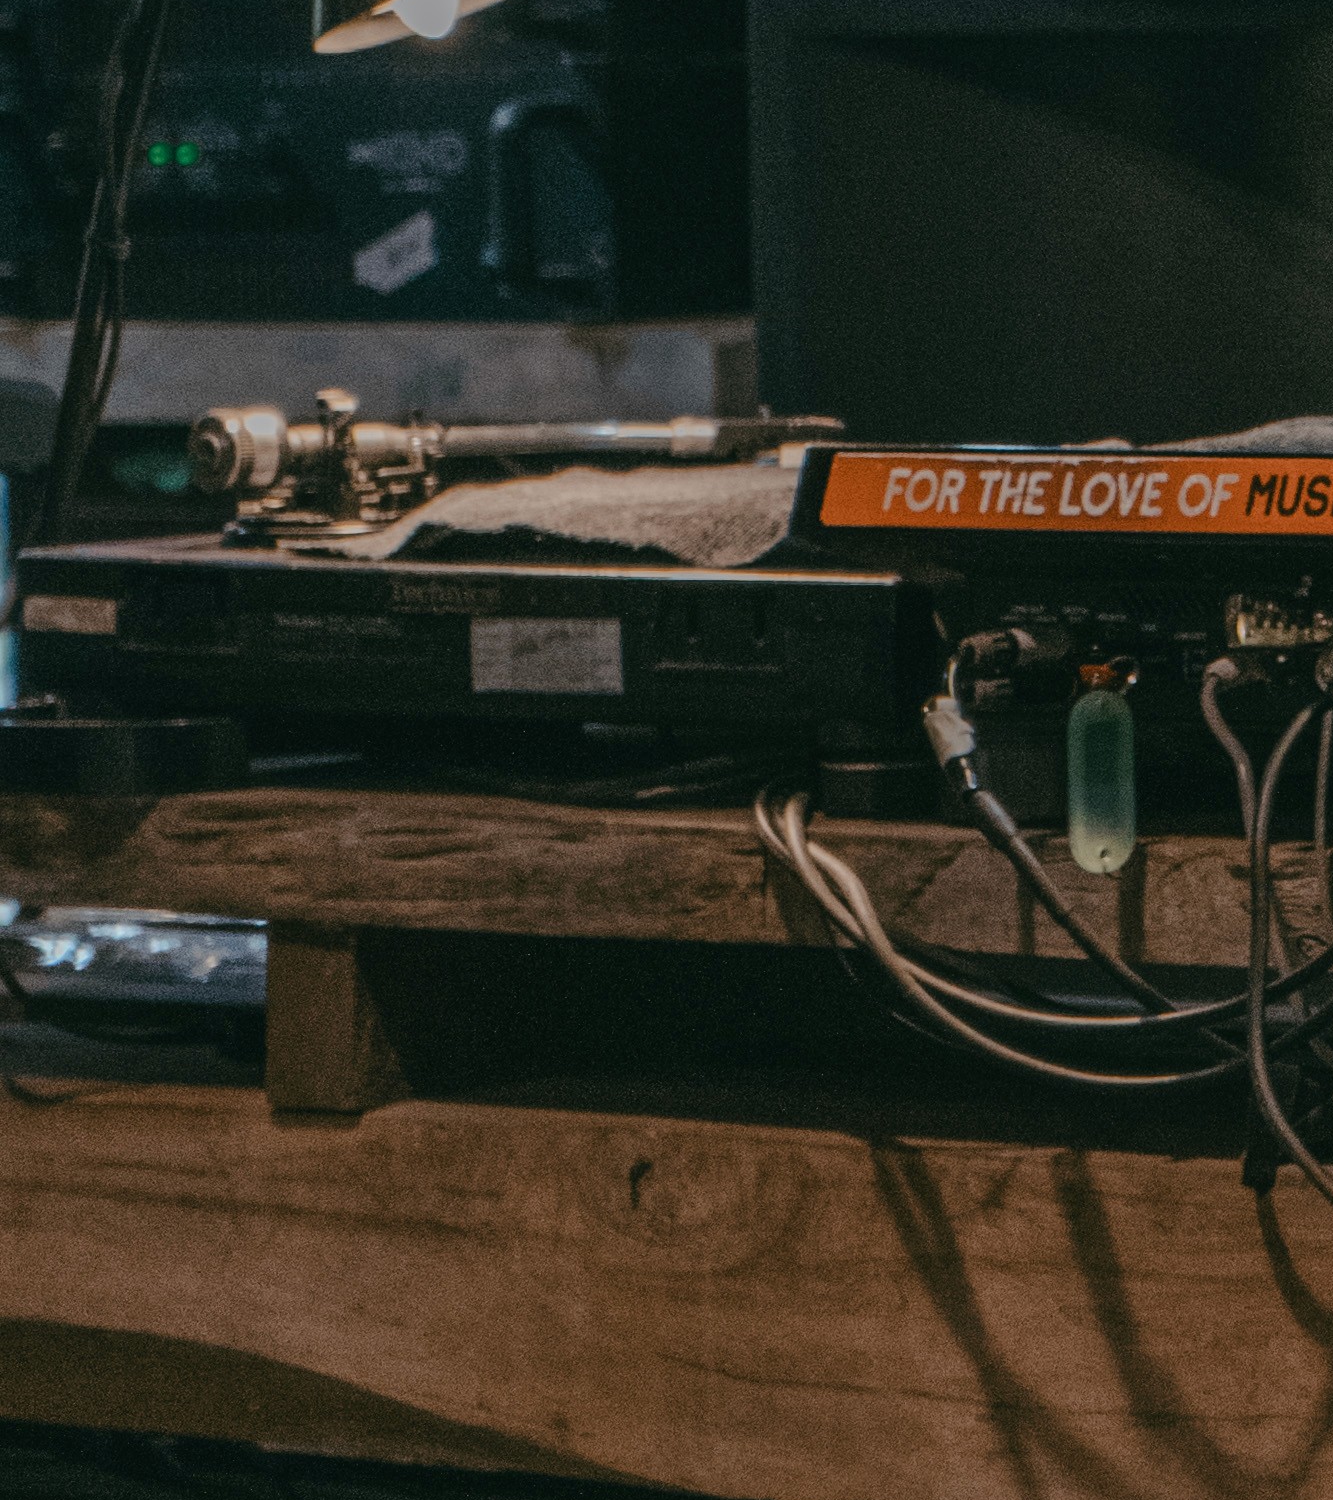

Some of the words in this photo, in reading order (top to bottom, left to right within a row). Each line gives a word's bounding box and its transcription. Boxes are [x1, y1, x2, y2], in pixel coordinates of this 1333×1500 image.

[882, 467, 965, 513] FOR
[978, 470, 1053, 516] THE
[1057, 471, 1169, 517] LOVE
[1177, 473, 1239, 518] OF
